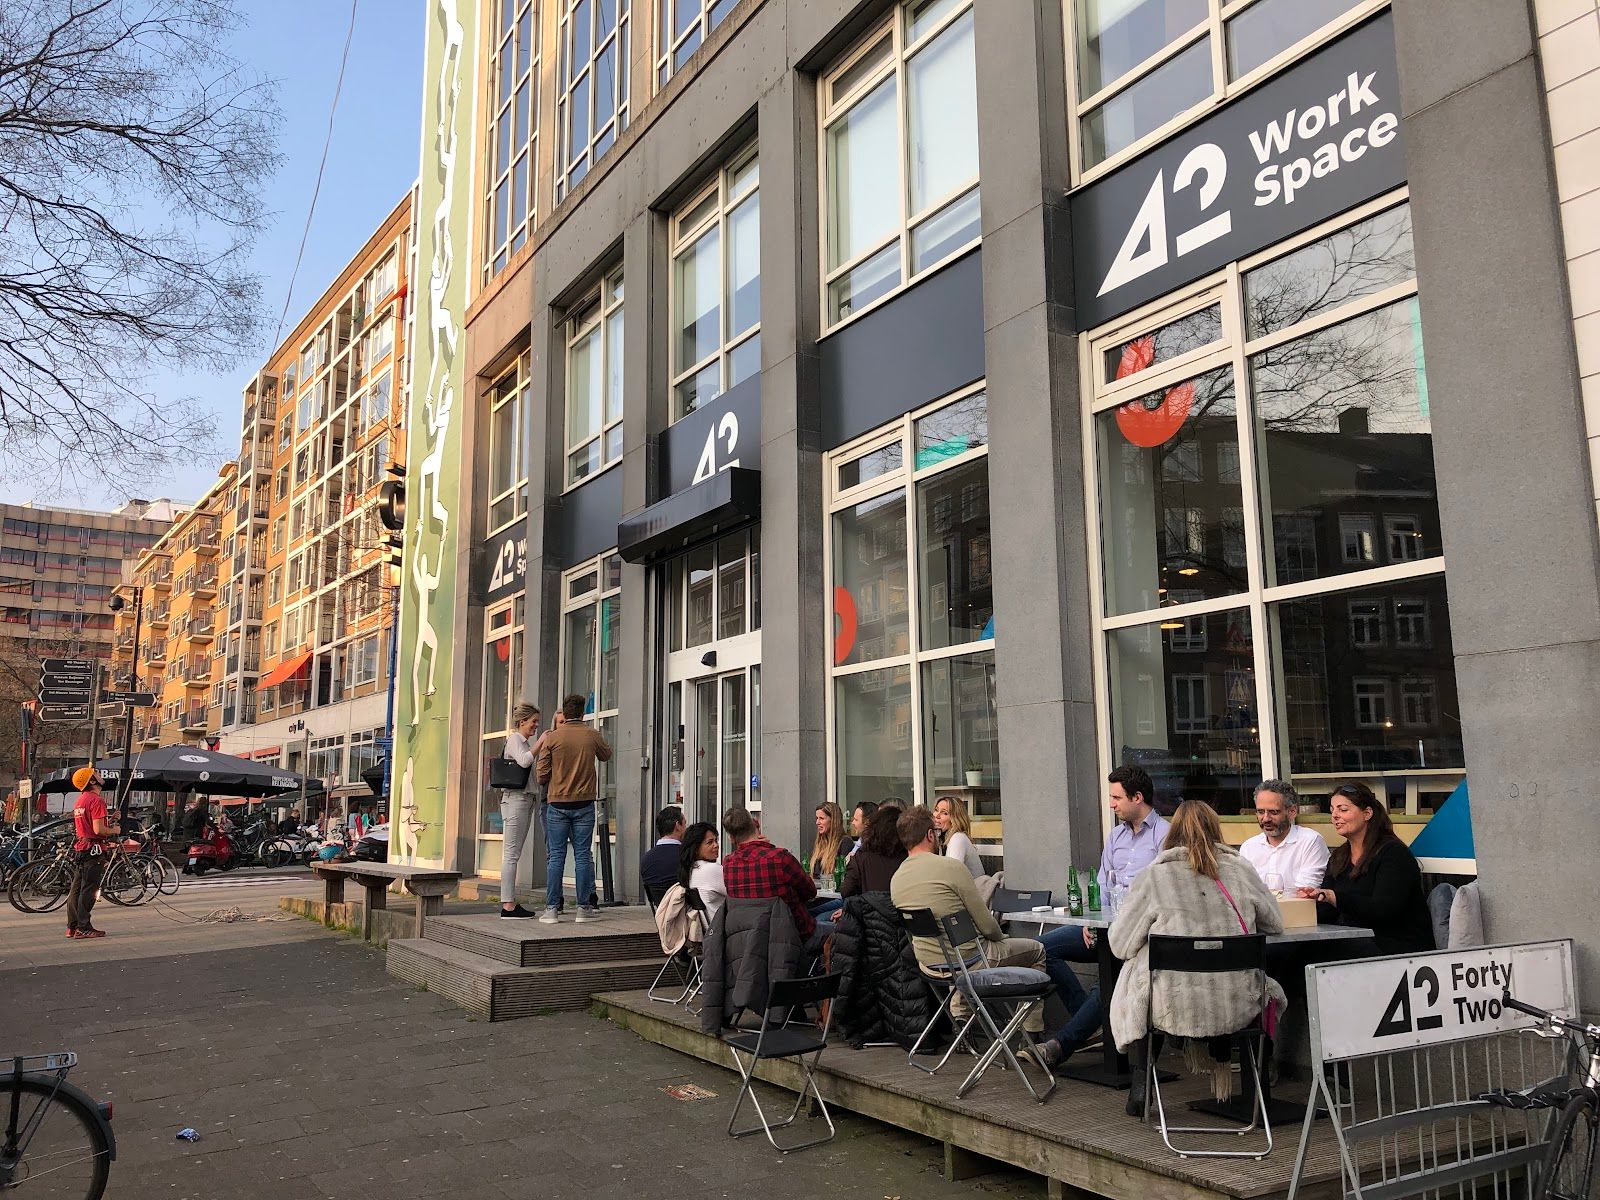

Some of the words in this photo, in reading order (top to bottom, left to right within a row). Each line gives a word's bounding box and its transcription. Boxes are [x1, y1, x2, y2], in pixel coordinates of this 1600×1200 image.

[1247, 71, 1380, 165] Work
[1254, 112, 1399, 207] Space
[1096, 143, 1232, 298] 42
[692, 411, 740, 486] 42
[488, 539, 514, 593] 42
[1373, 965, 1443, 1038] 42
[1451, 960, 1513, 991] Forty
[1453, 997, 1502, 1025] Two
